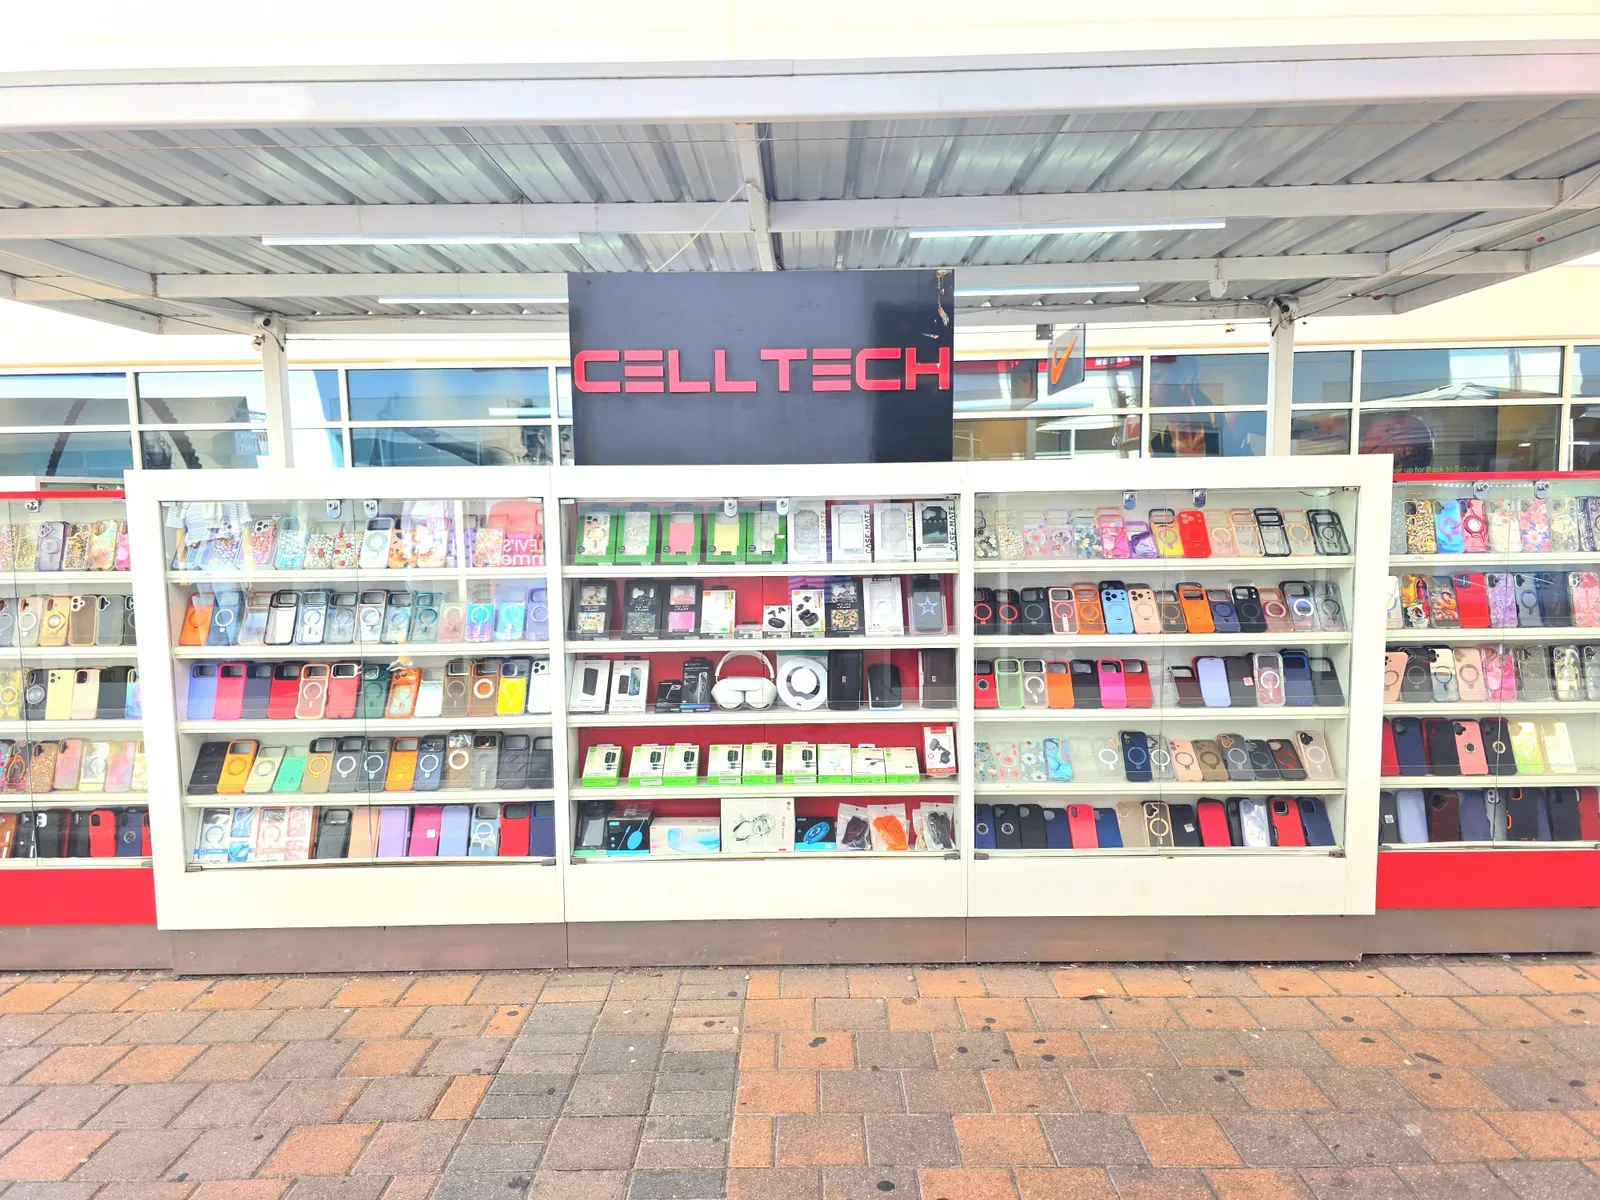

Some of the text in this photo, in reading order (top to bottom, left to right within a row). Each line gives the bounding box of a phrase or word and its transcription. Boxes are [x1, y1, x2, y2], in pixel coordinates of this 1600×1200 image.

[573, 346, 951, 393] CELL TECH
[1426, 465, 1444, 473] Back
